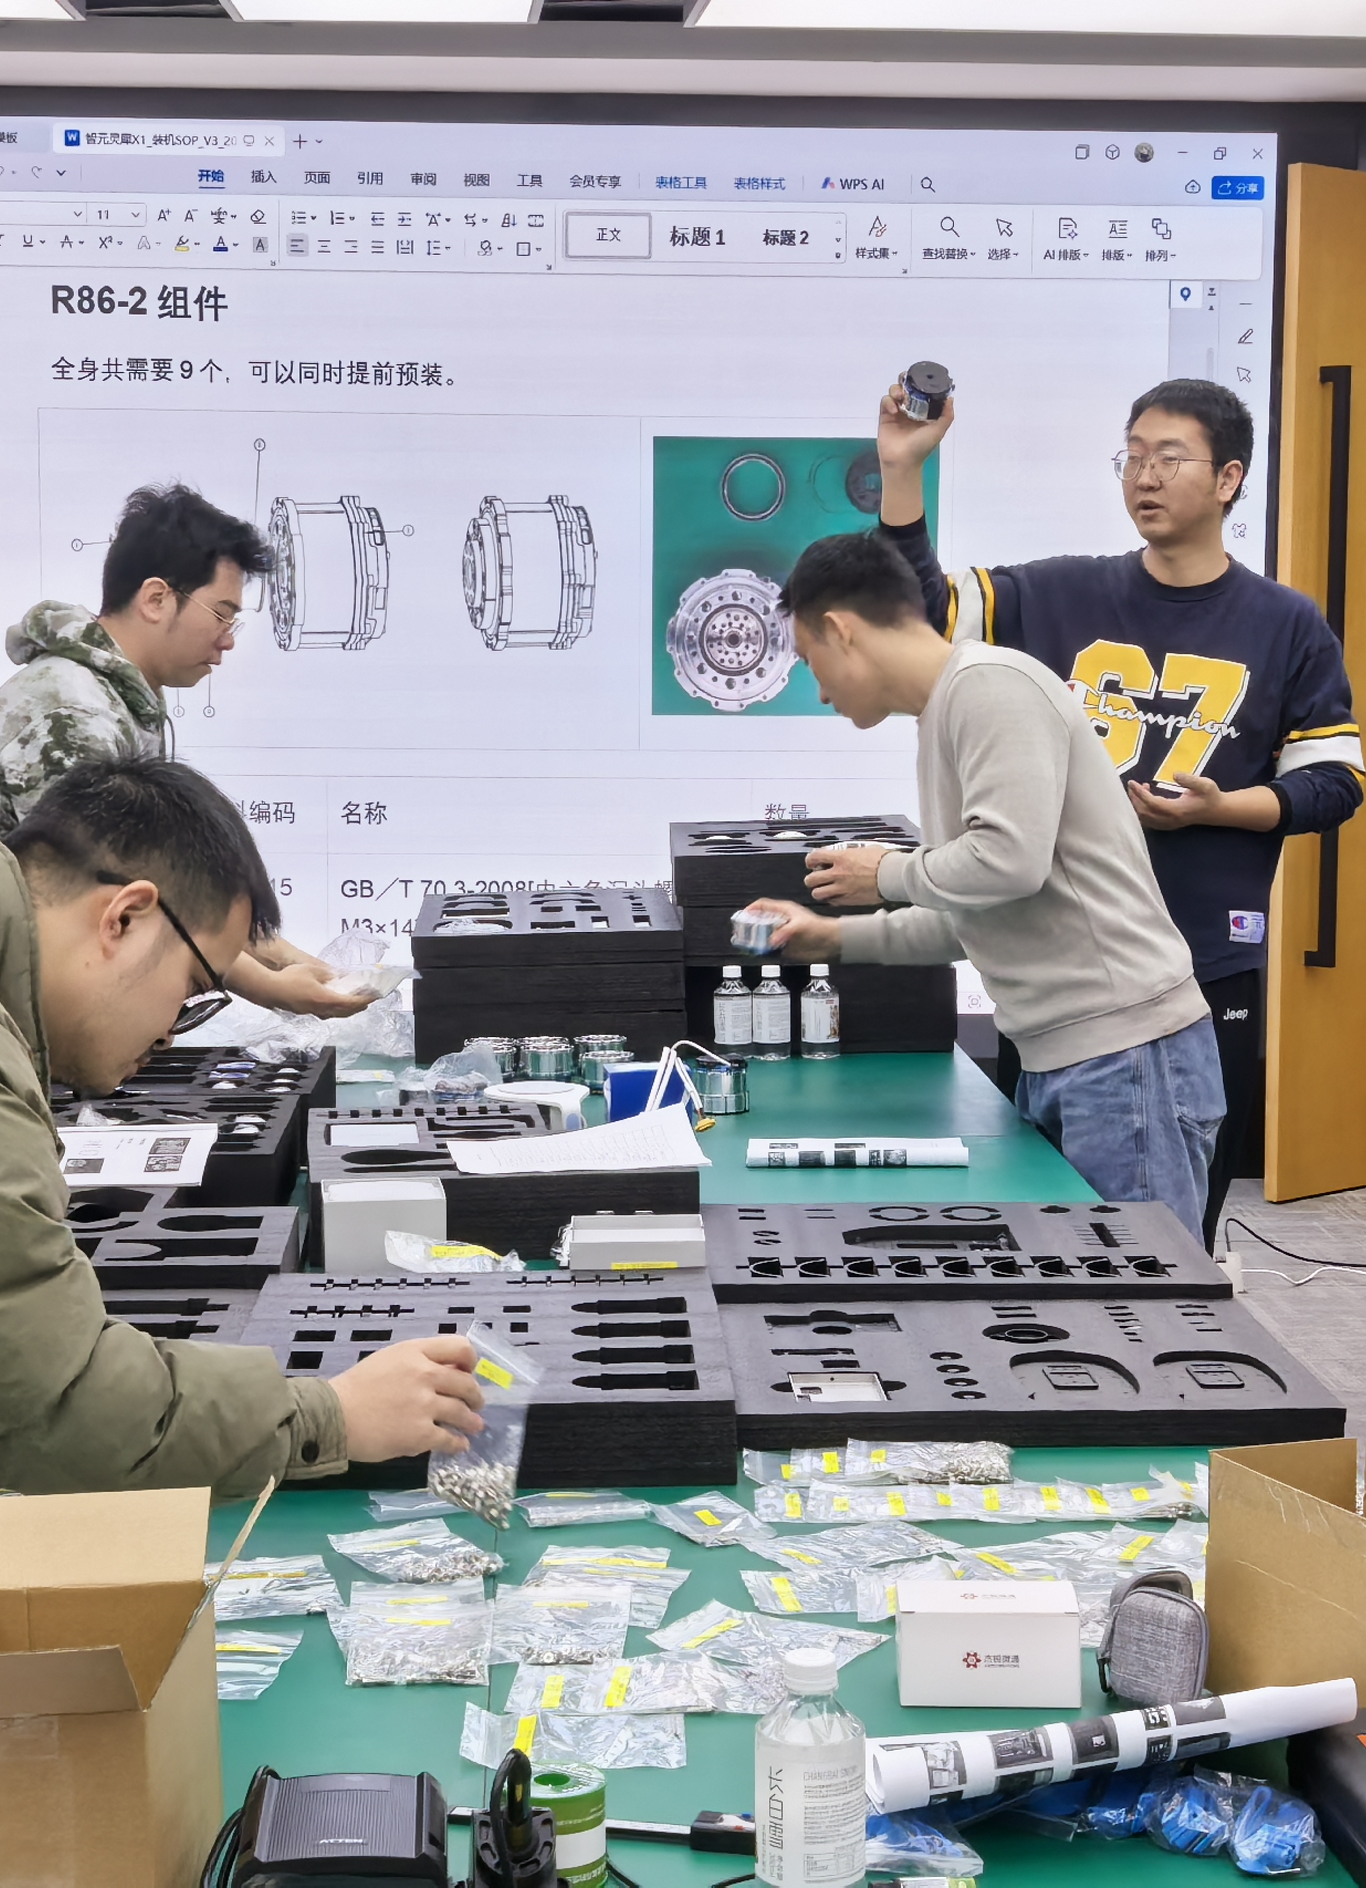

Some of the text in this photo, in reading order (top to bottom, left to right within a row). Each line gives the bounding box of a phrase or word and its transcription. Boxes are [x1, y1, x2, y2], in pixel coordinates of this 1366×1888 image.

[197, 169, 225, 184] 开始
[251, 169, 277, 184] 插入
[304, 171, 331, 185] 页面
[357, 172, 384, 186] 引用
[410, 173, 437, 187] 审阅
[463, 173, 491, 187] 视图
[516, 174, 543, 188] 工具
[569, 174, 622, 189] 会员专享
[655, 175, 708, 190] 表格工具
[733, 176, 786, 191] 表格样式
[839, 177, 885, 191] WPS AI
[1234, 181, 1259, 196] 分享
[97, 209, 109, 220] 11
[596, 227, 622, 243] 正文
[669, 225, 726, 247] 标题 1
[762, 229, 810, 247] 标题 2
[922, 248, 968, 260] 查找替换
[987, 248, 1012, 261] 选择
[1043, 248, 1081, 261] AI 排版
[1101, 249, 1125, 261] 排版
[1145, 249, 1168, 262] 排列
[50, 284, 229, 322] R86-2 组件
[51, 356, 174, 383] 全身共需要
[179, 359, 194, 380] 9
[340, 800, 389, 826] 名称
[764, 802, 811, 820] 数量
[1223, 1007, 1249, 1021] Jeep
